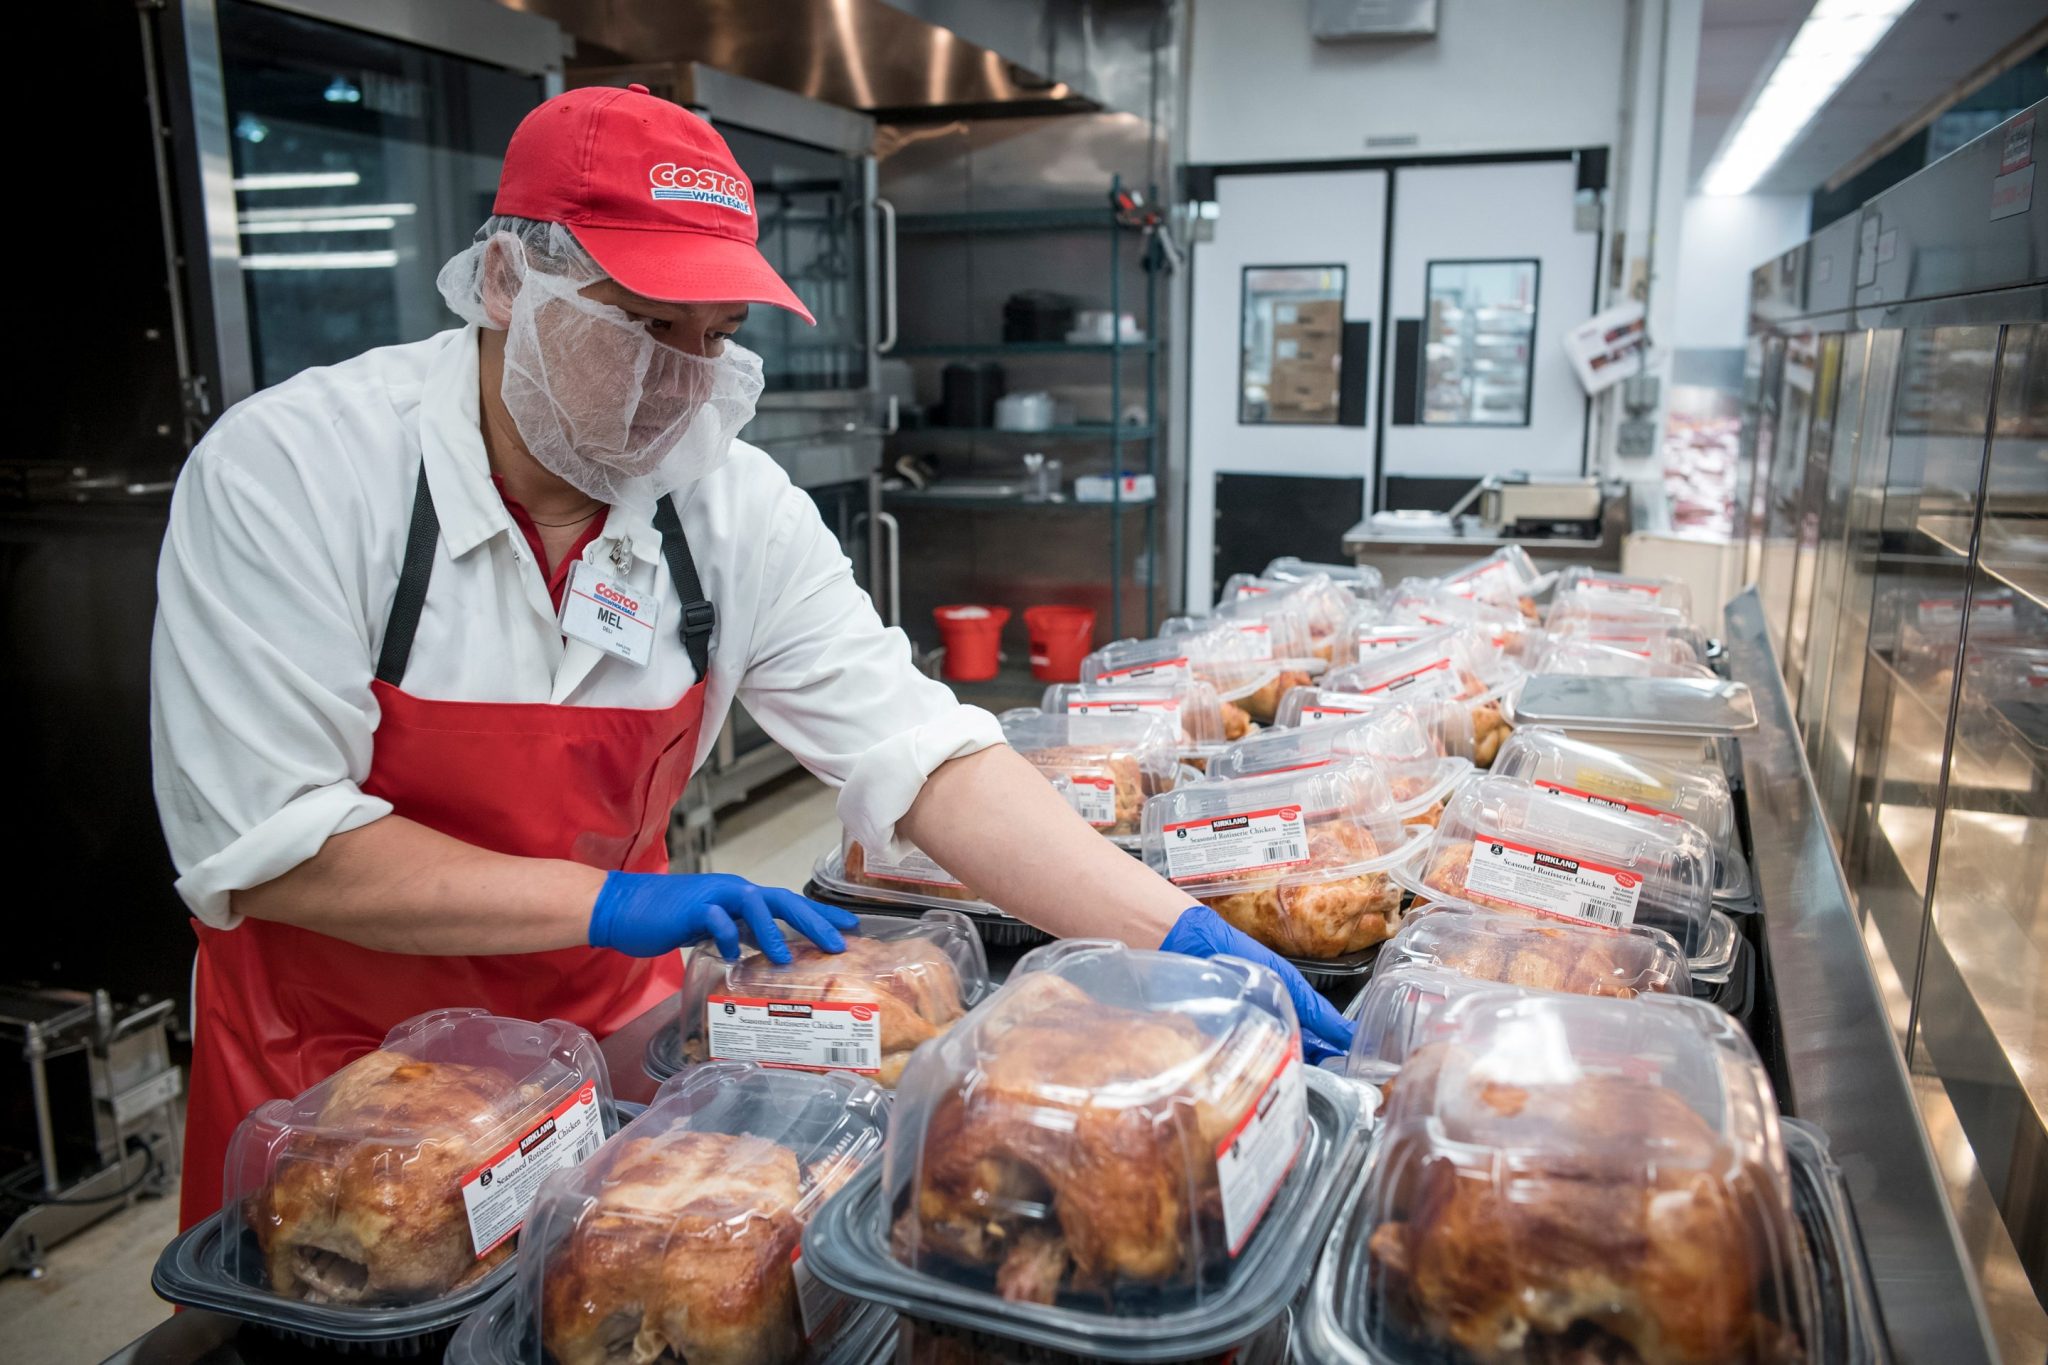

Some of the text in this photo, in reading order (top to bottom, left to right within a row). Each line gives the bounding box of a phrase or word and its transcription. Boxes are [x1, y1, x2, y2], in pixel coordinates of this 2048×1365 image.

[650, 163, 748, 203] COSTCO
[692, 190, 750, 213] WHOLESALE
[595, 582, 638, 611] COSTCO
[607, 599, 636, 617] WHOLESALE
[597, 607, 623, 630] MEL
[602, 625, 613, 634] DELI
[1589, 796, 1627, 812] KIRKLAND
[1213, 816, 1248, 829] KIRKLAND
[1190, 833, 1217, 843] Seasoned
[1218, 829, 1248, 840] Rotisserie
[1249, 825, 1276, 836] Chicken
[1536, 853, 1578, 869] KIRKLAND
[1503, 858, 1536, 872] Seasoned
[1537, 867, 1572, 881] Rotisserie
[1574, 876, 1606, 890] Chicken
[738, 1016, 773, 1026] Seasoned
[774, 1018, 810, 1028] Rotisserie
[811, 1021, 844, 1030] Chicken
[520, 1119, 554, 1150] KIRKLAND
[496, 1118, 582, 1186] Seasoned Rotisserie Chicken
